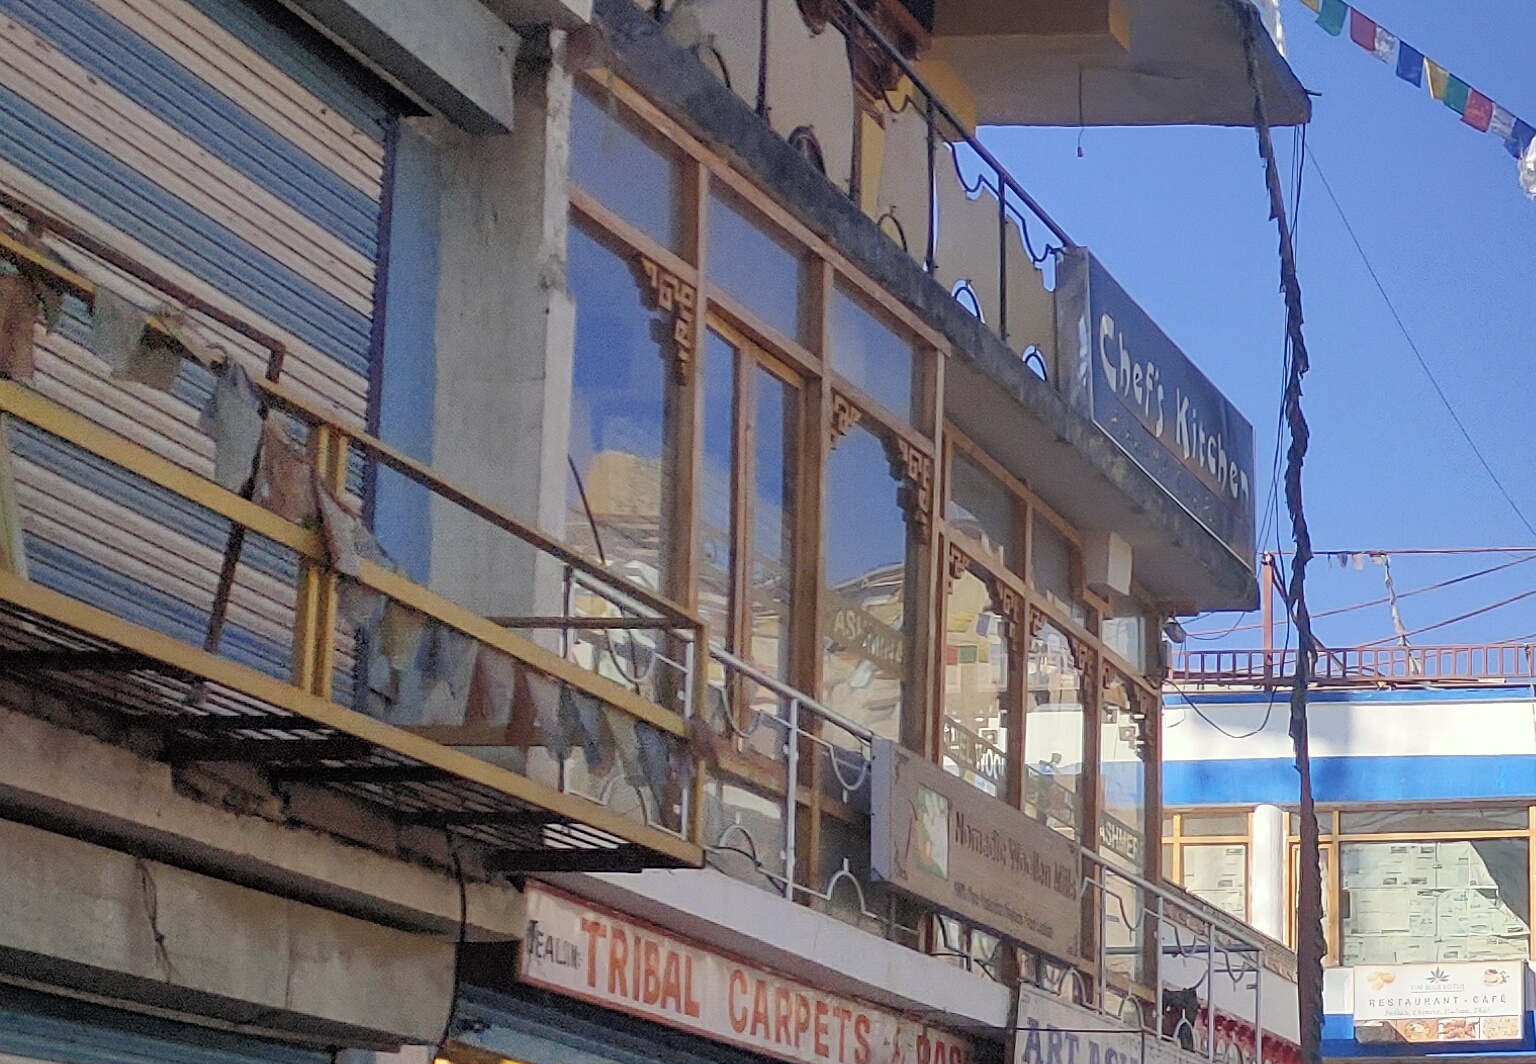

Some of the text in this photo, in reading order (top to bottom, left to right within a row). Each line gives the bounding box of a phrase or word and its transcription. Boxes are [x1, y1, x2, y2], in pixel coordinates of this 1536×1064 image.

[1100, 312, 1250, 503] Chef's Kitchen
[582, 916, 701, 1019] TRIBAL
[1368, 997, 1459, 1008] RESTAURANT
